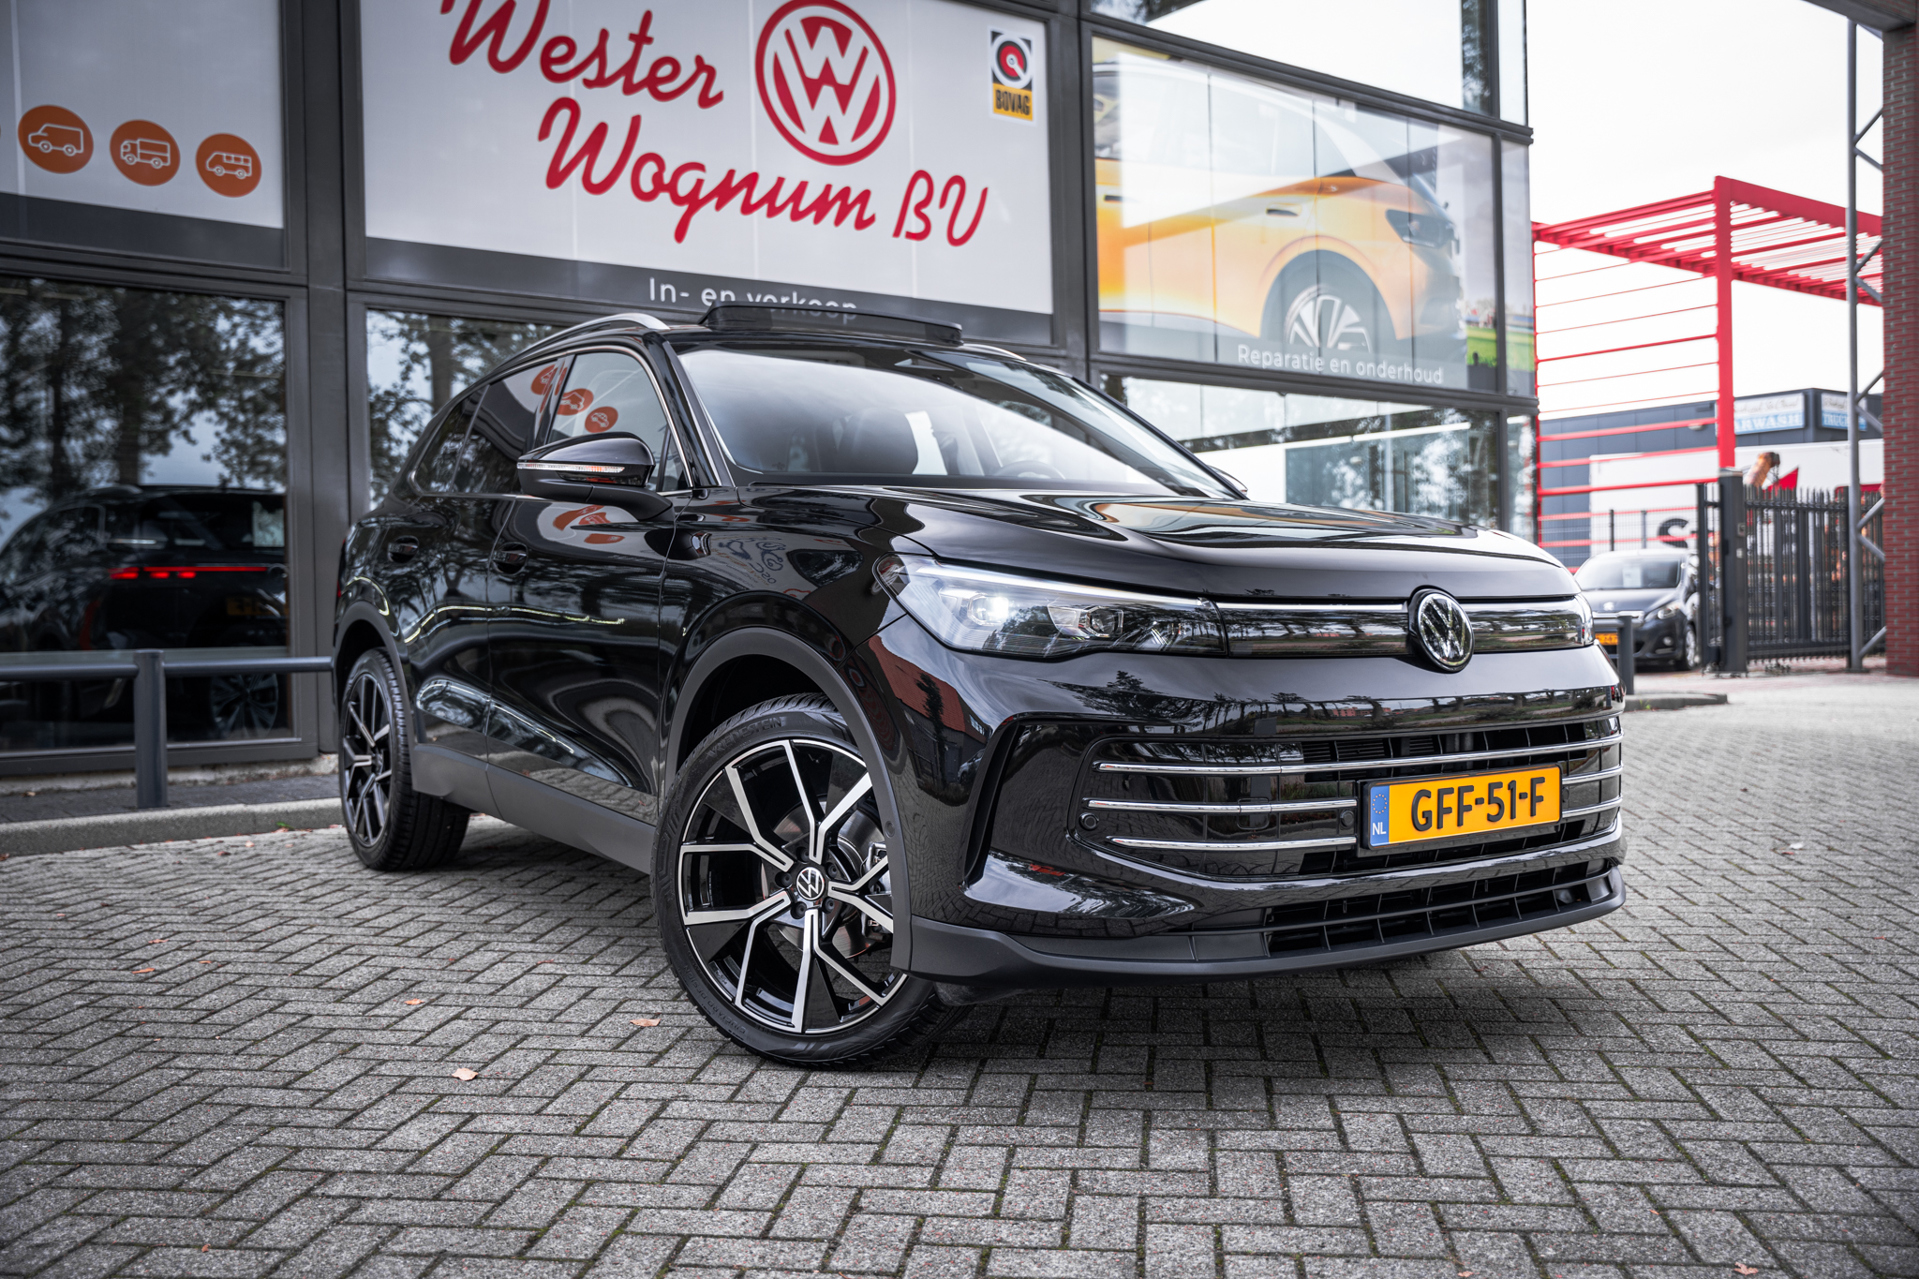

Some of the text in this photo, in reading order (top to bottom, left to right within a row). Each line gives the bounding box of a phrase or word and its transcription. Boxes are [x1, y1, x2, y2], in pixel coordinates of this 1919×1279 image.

[440, 0, 724, 109] Wester
[996, 89, 1030, 116] BOVAG
[538, 97, 989, 247] Wognum BV
[650, 277, 690, 303] In-
[701, 288, 736, 306] en
[1237, 344, 1444, 385] Reparatie en onderhoud
[1735, 413, 1802, 432] ARWASH
[1411, 776, 1546, 832] GFF-51-F
[1372, 821, 1387, 836] NL
